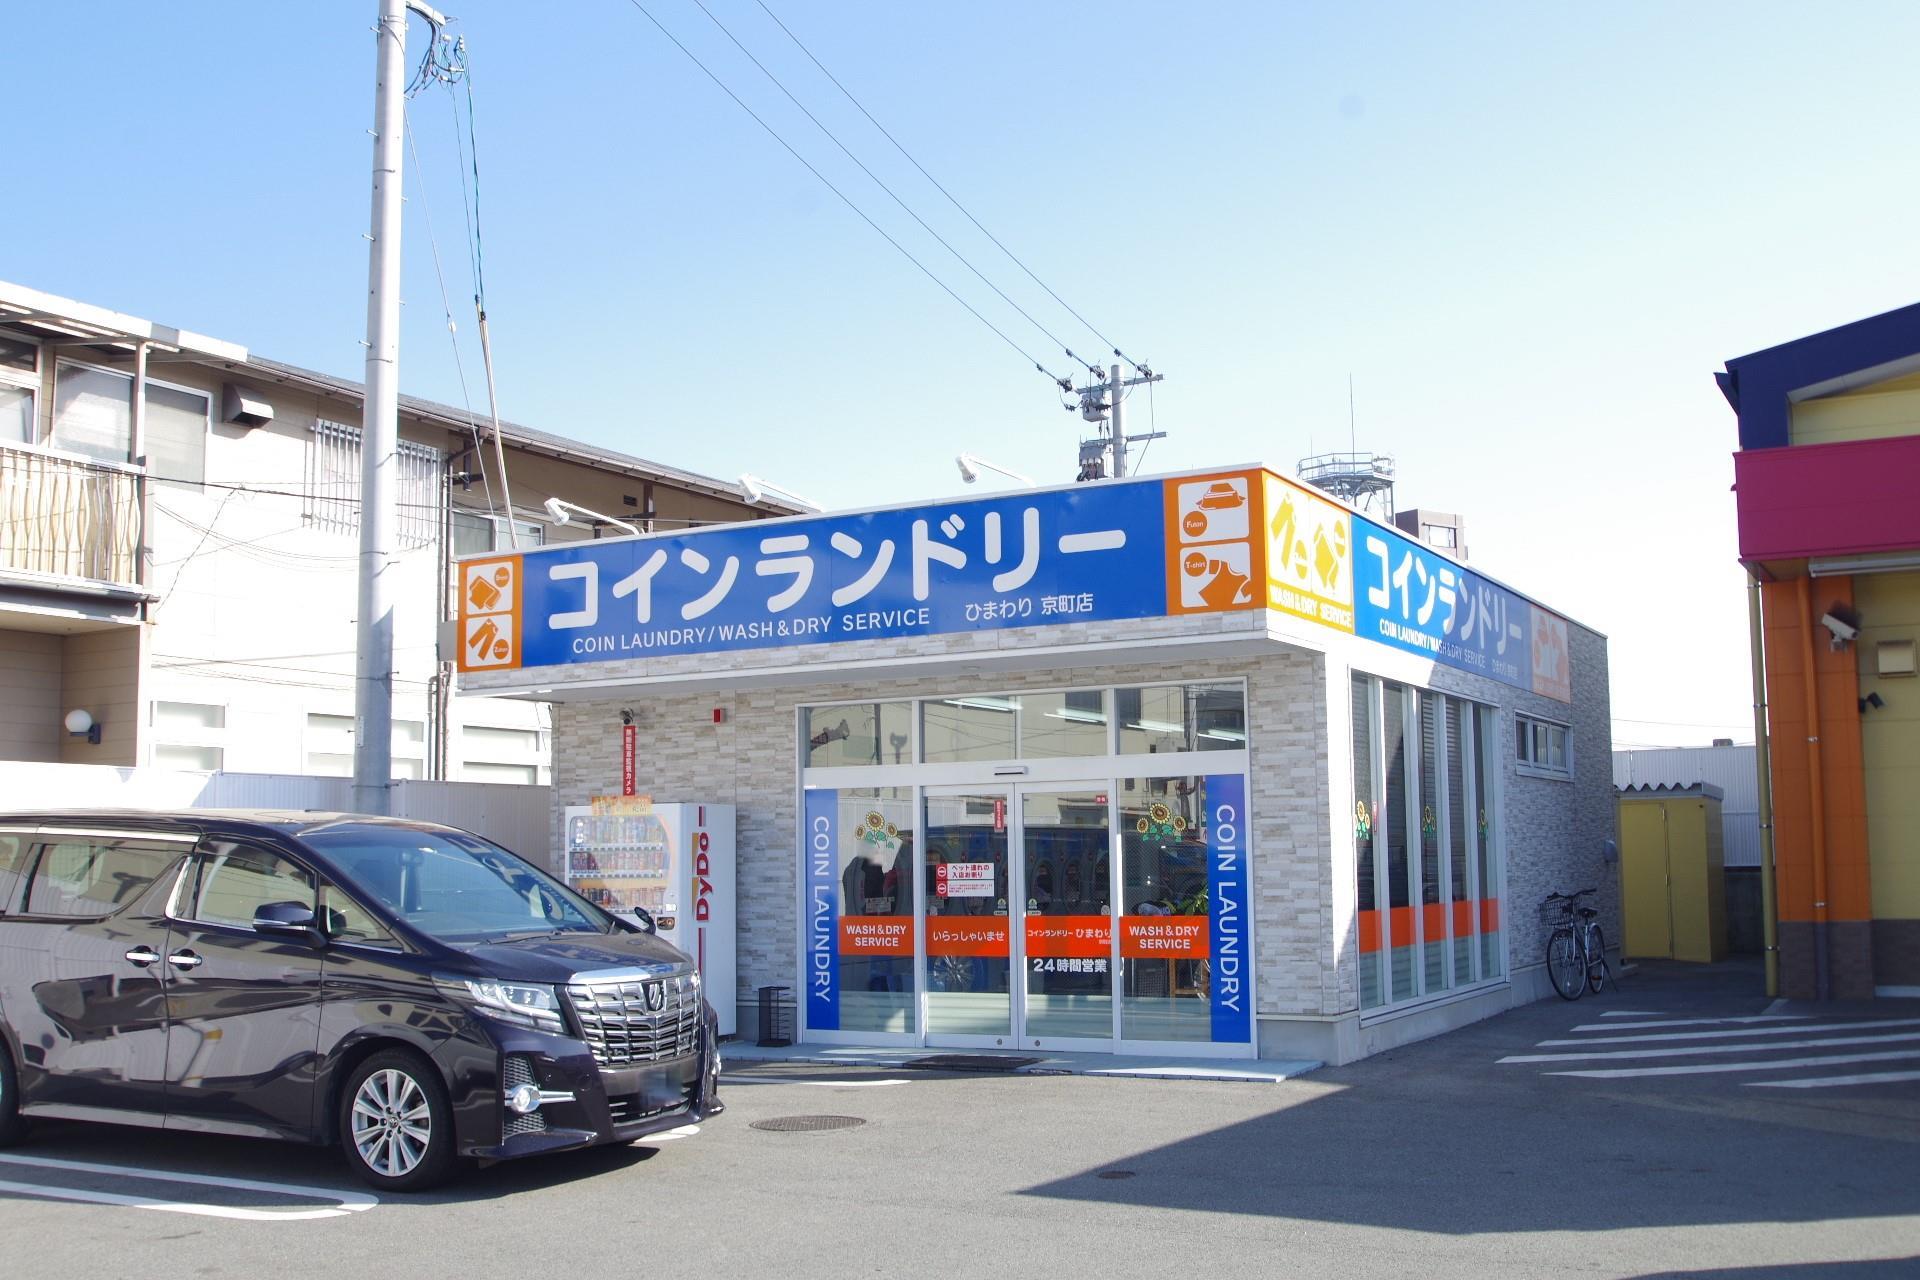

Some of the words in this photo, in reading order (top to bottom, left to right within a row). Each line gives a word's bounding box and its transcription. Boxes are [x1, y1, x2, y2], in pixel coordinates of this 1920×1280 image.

[549, 507, 1126, 630] コインランドリー
[965, 598, 1032, 622] ひまわり
[1041, 593, 1094, 614] 京町店
[1367, 535, 1522, 655] コインランドリー
[572, 635, 615, 654] COIN
[842, 608, 930, 632] SERVICE
[1464, 649, 1485, 668] SERVICE
[814, 816, 829, 876] COIN
[1216, 804, 1236, 871] COIN
[814, 885, 830, 1003] LAUNDRY
[855, 937, 899, 947] SERVICE
[933, 930, 1005, 942] いらっしゃいませ
[1139, 938, 1191, 949] SERVICE
[1218, 882, 1240, 1013] LAUNDRY
[1033, 958, 1107, 973] 24時間営業
